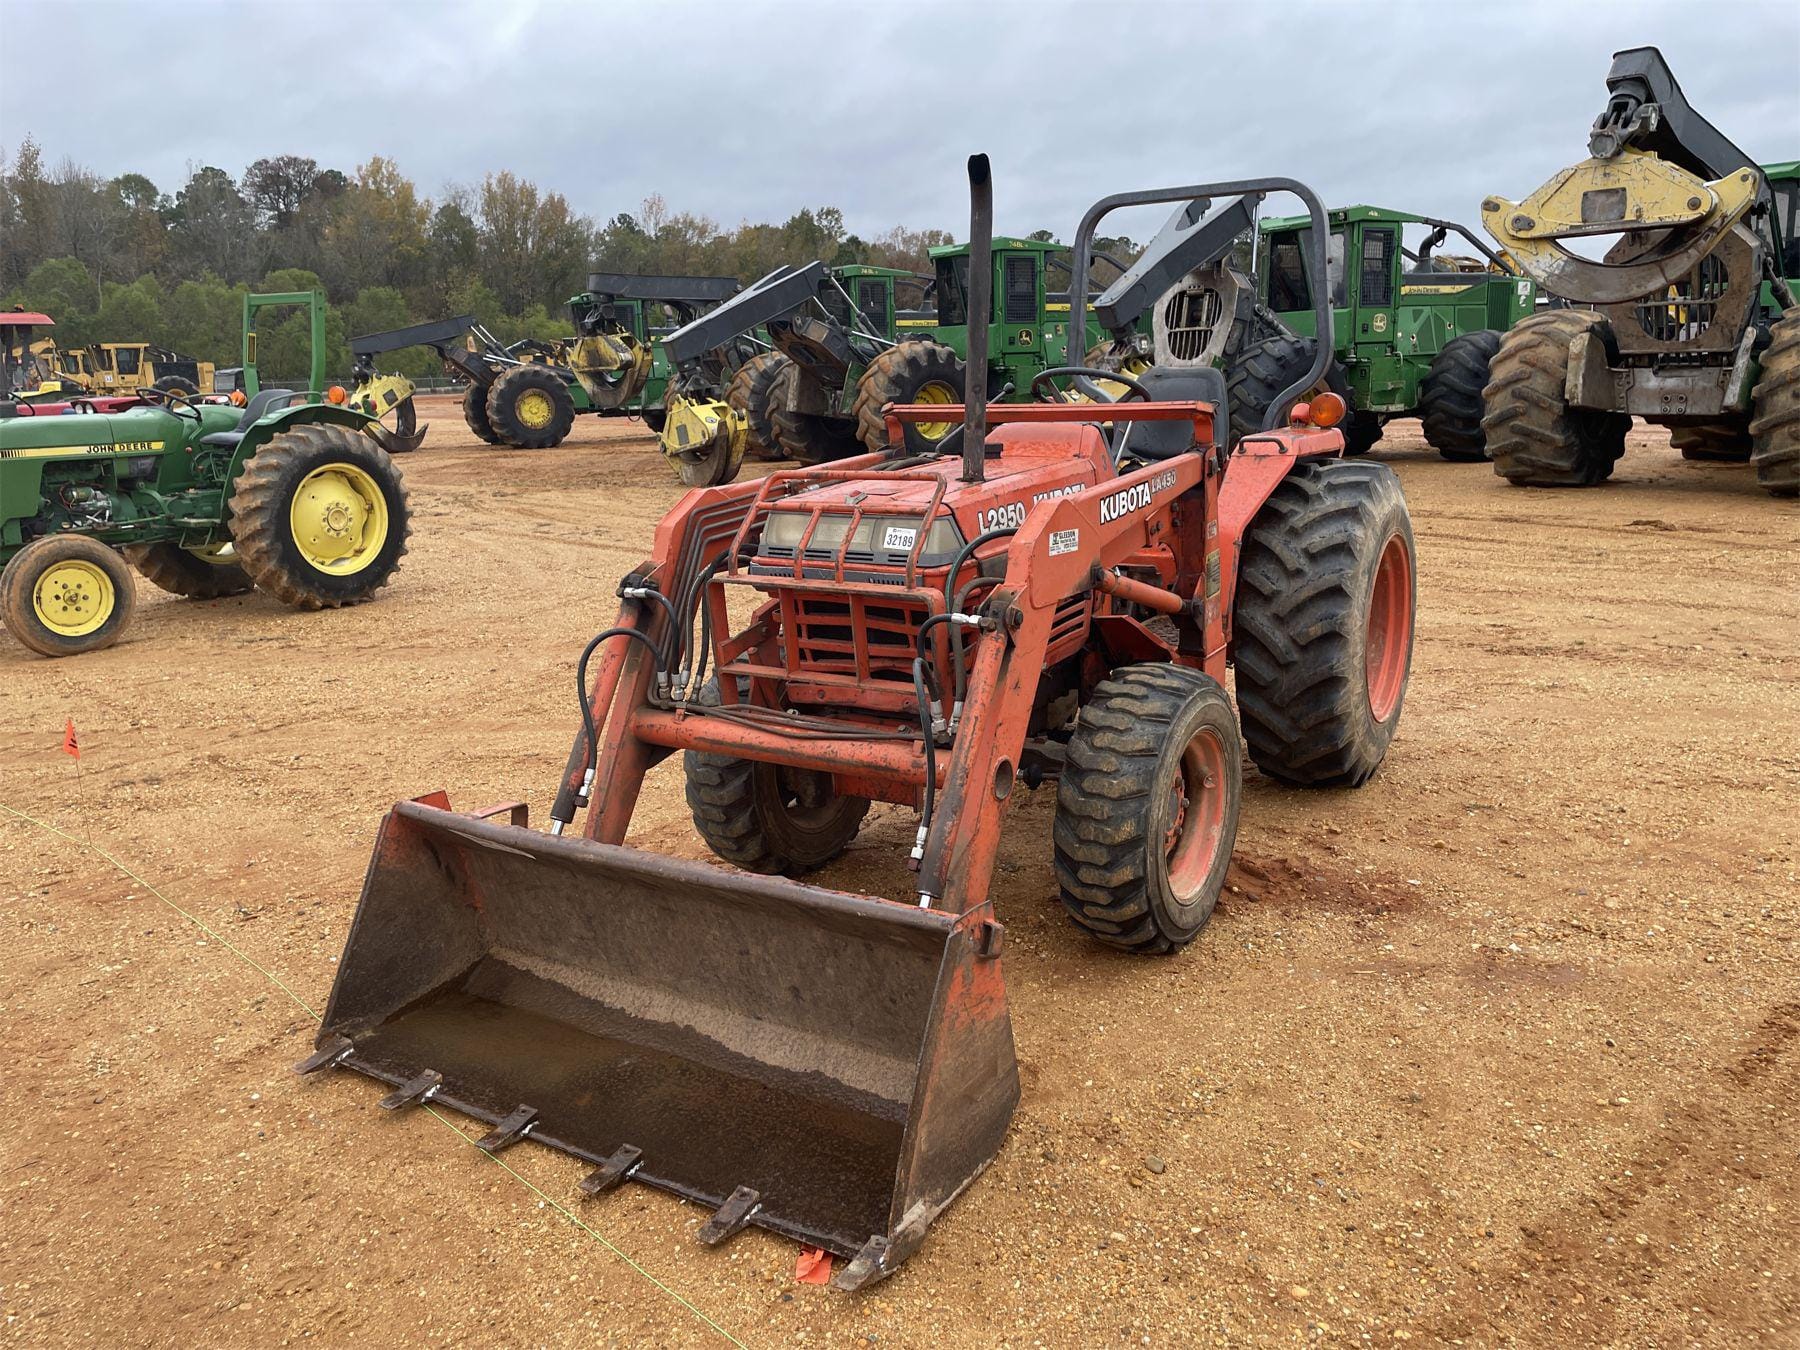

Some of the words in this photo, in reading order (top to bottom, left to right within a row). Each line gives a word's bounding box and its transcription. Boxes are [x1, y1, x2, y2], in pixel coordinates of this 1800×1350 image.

[87, 445, 114, 454] JOHN
[120, 442, 152, 451] DEERE
[1100, 481, 1152, 525] KUBOTA
[1151, 469, 1176, 494] LA450
[977, 501, 1026, 537] L2950
[886, 534, 913, 548] 32189
